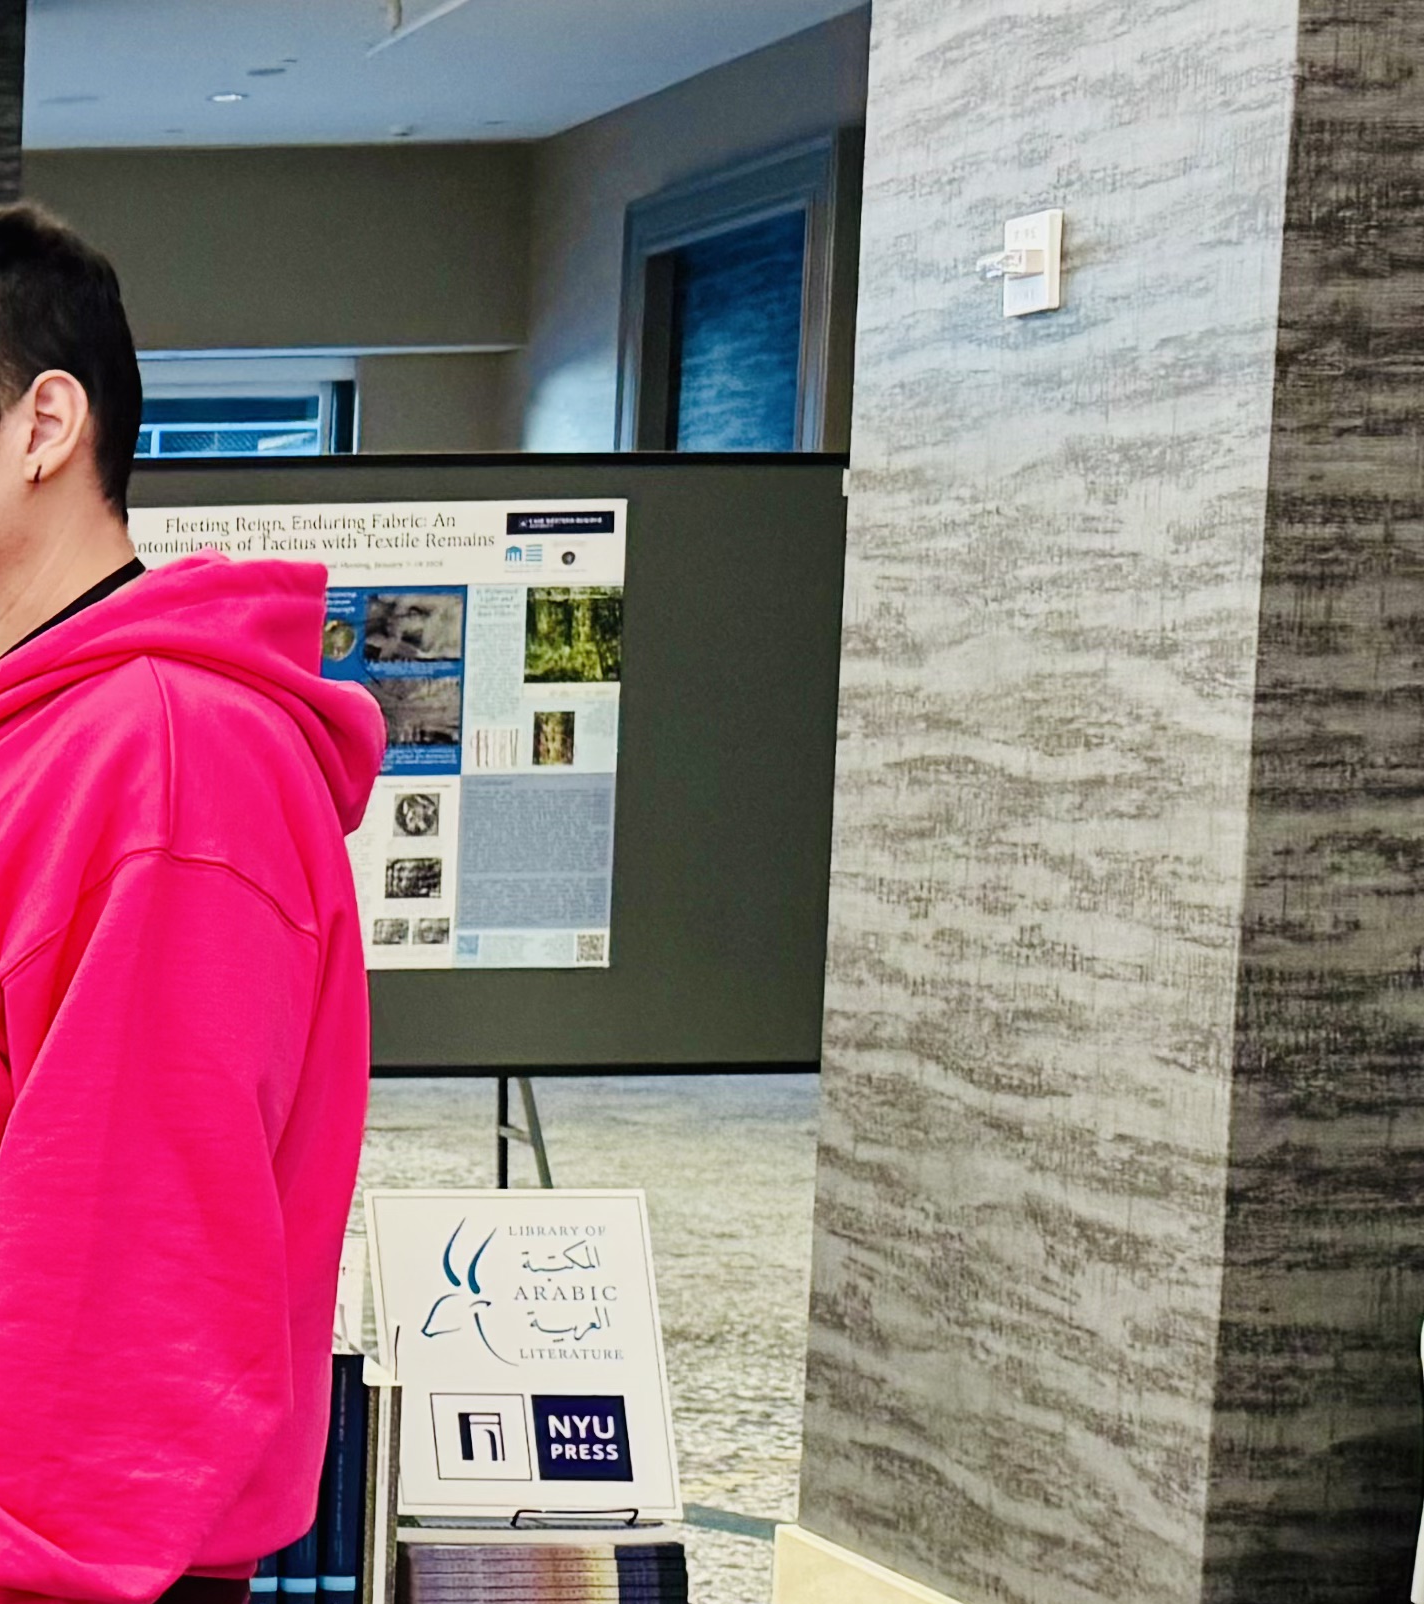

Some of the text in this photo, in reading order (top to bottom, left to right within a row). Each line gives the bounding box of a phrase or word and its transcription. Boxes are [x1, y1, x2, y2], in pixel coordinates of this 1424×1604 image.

[166, 517, 229, 536] Fleeting
[292, 513, 366, 534] Enduring
[432, 512, 456, 527] An
[237, 535, 252, 551] of
[258, 535, 316, 551] Tacitus
[322, 534, 357, 549] with
[364, 532, 419, 548] Textile
[426, 532, 495, 548] Remains
[509, 1225, 606, 1237] LIBRARY OF
[521, 1240, 601, 1282] المكتبة
[514, 1285, 617, 1301] ARABIC
[527, 1306, 610, 1342] العربية
[519, 1348, 624, 1360] LITERATURE
[548, 1415, 615, 1439] NYU
[551, 1444, 619, 1460] PRESS
